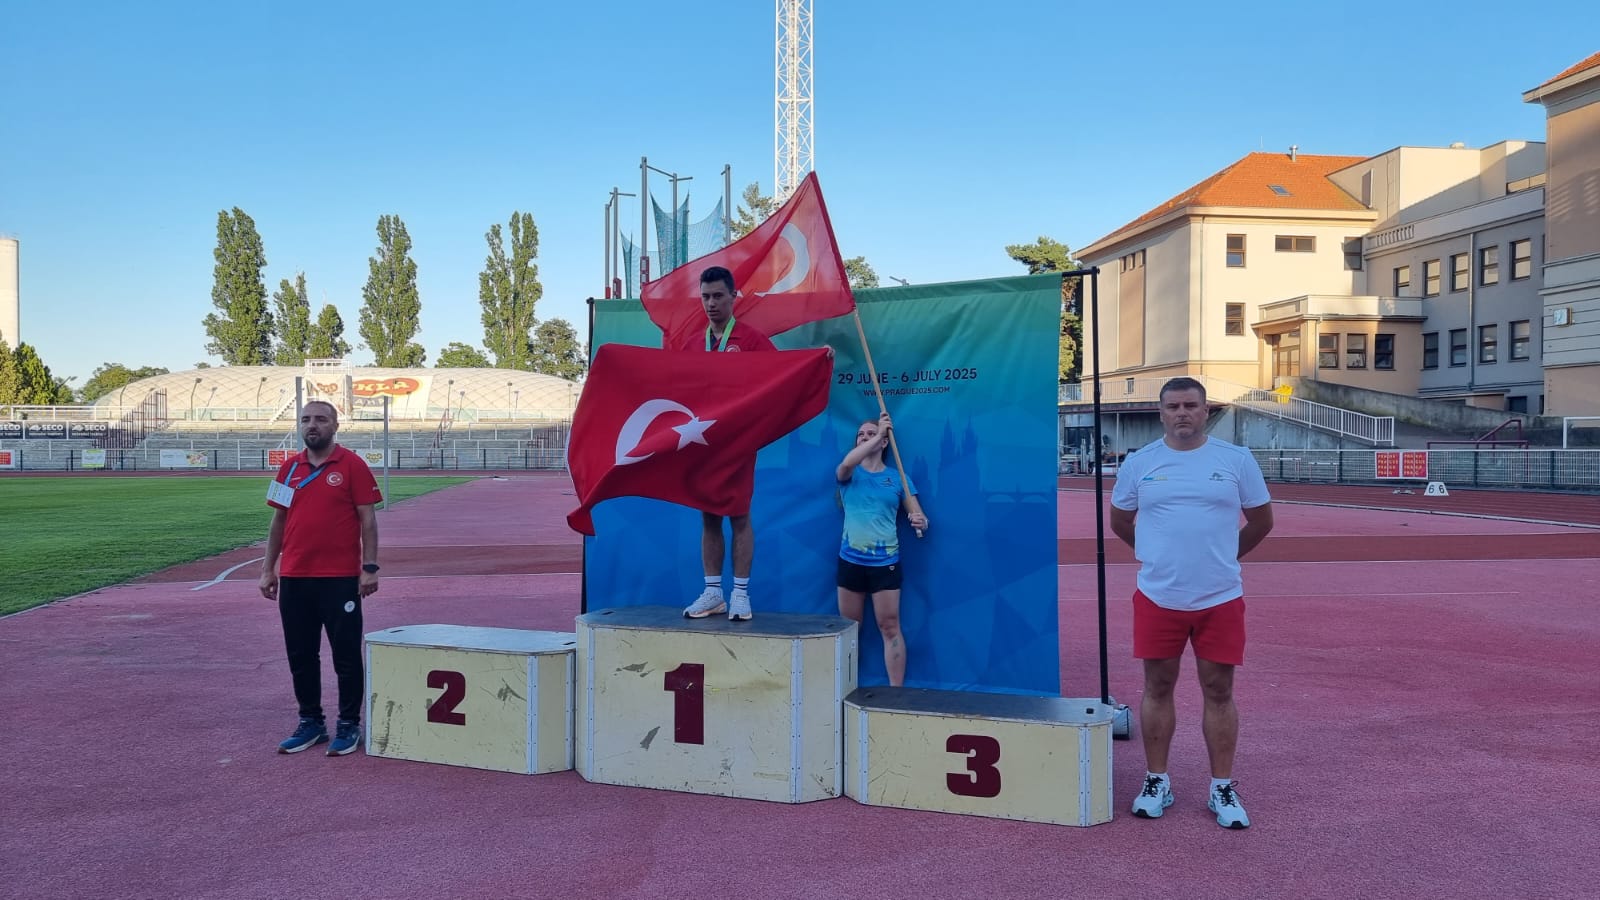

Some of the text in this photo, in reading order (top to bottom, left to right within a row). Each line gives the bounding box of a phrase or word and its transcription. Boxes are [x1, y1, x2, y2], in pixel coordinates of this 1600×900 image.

[838, 372, 854, 384] 29
[901, 371, 909, 382] 6
[912, 369, 941, 382] JULY
[944, 368, 977, 380] 2025
[1428, 484, 1445, 494] 6 6
[426, 670, 466, 726] 2
[664, 663, 705, 745] 1
[946, 734, 1001, 798] 3
